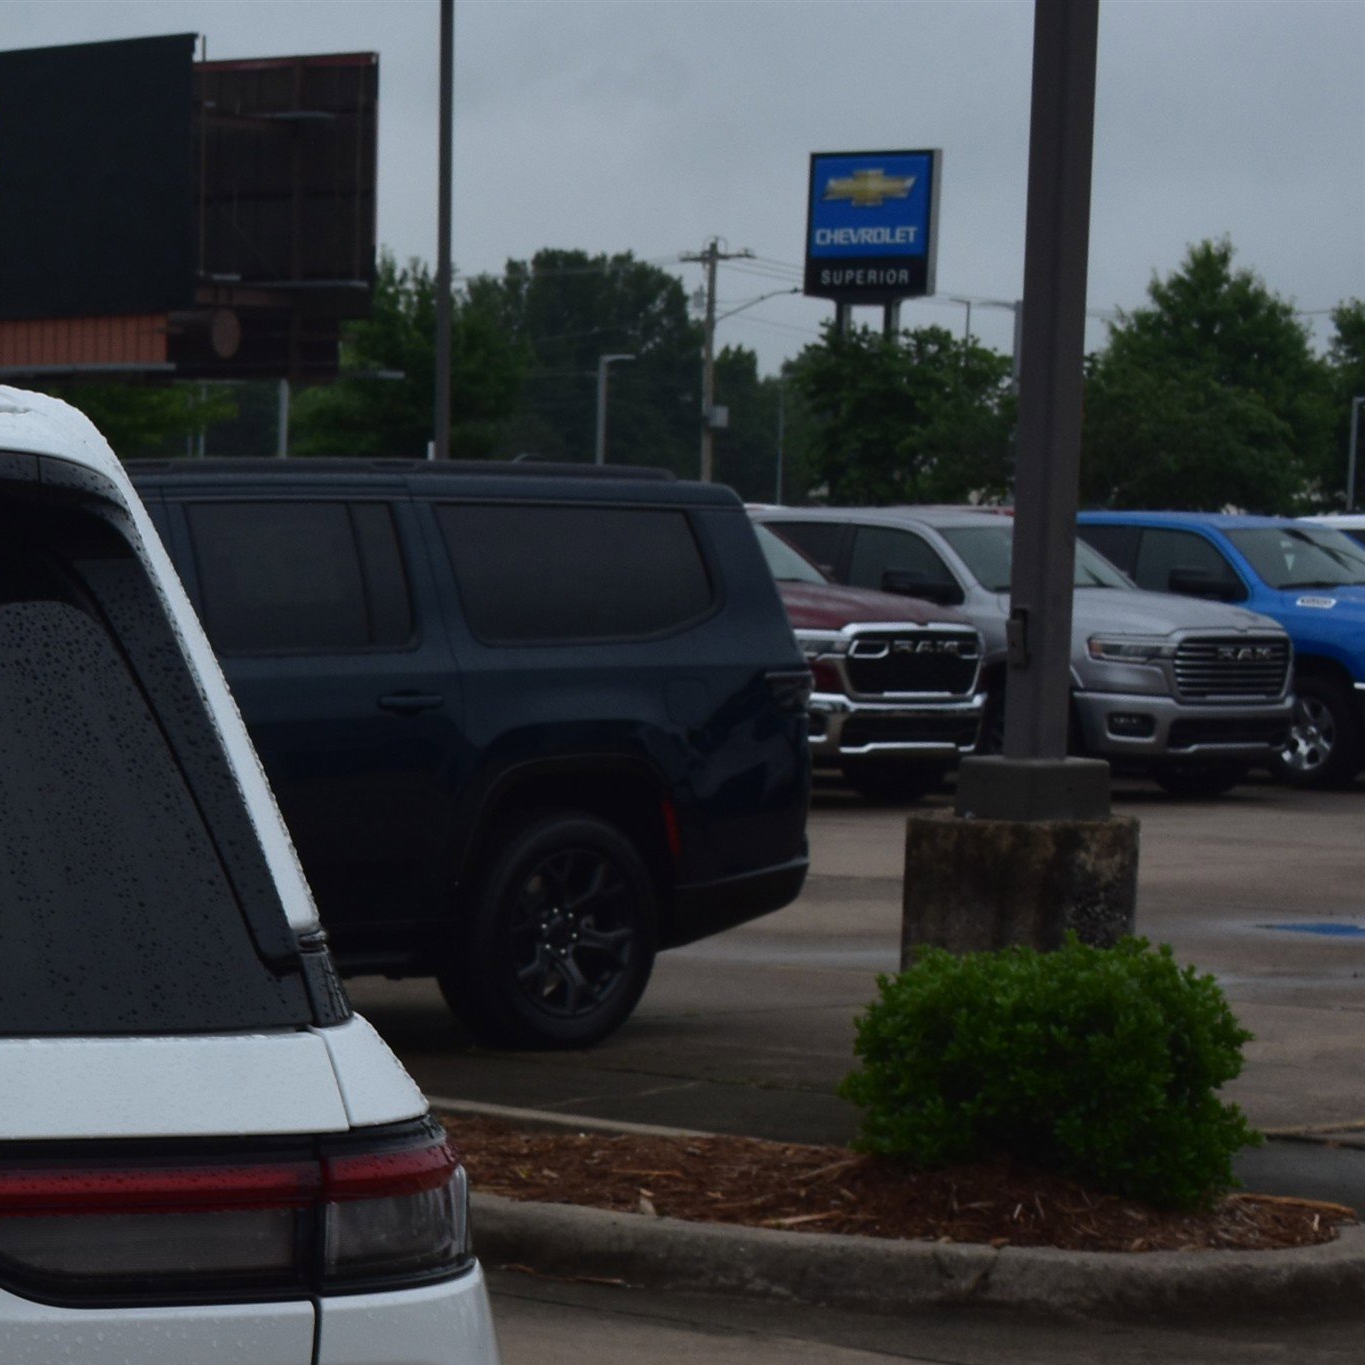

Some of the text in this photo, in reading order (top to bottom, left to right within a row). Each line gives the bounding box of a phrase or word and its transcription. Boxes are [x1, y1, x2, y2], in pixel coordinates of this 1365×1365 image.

[815, 226, 918, 245] CHEVROLET
[821, 268, 910, 285] SUPERIOR
[892, 639, 961, 655] RAM
[1217, 646, 1272, 661] RAM
